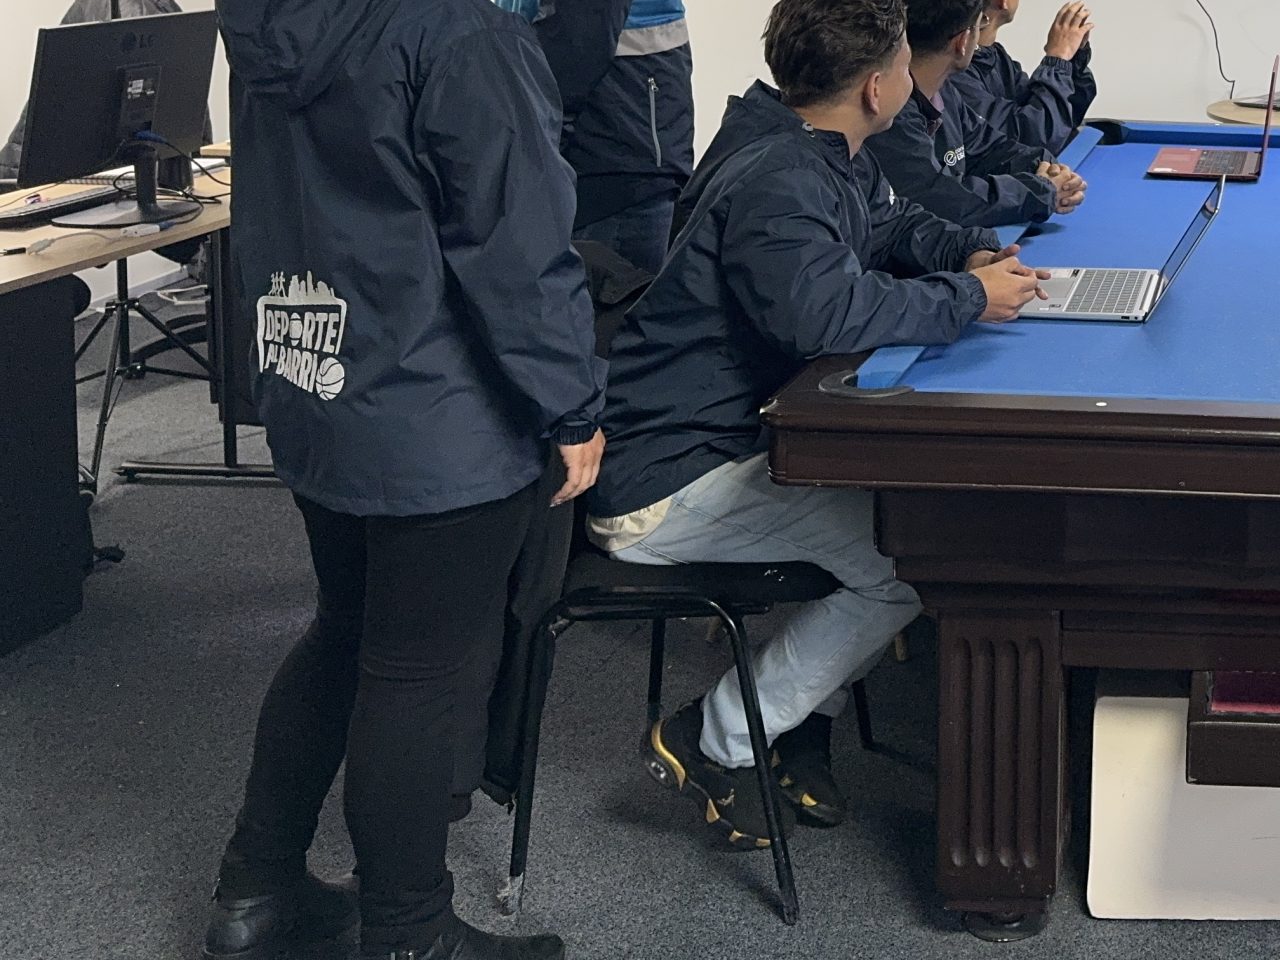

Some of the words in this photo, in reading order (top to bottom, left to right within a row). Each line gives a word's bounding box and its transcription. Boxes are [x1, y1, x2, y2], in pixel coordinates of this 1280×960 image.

[264, 309, 340, 354] DEPORTE
[264, 343, 279, 369] AL
[275, 345, 345, 400] BARRIO
